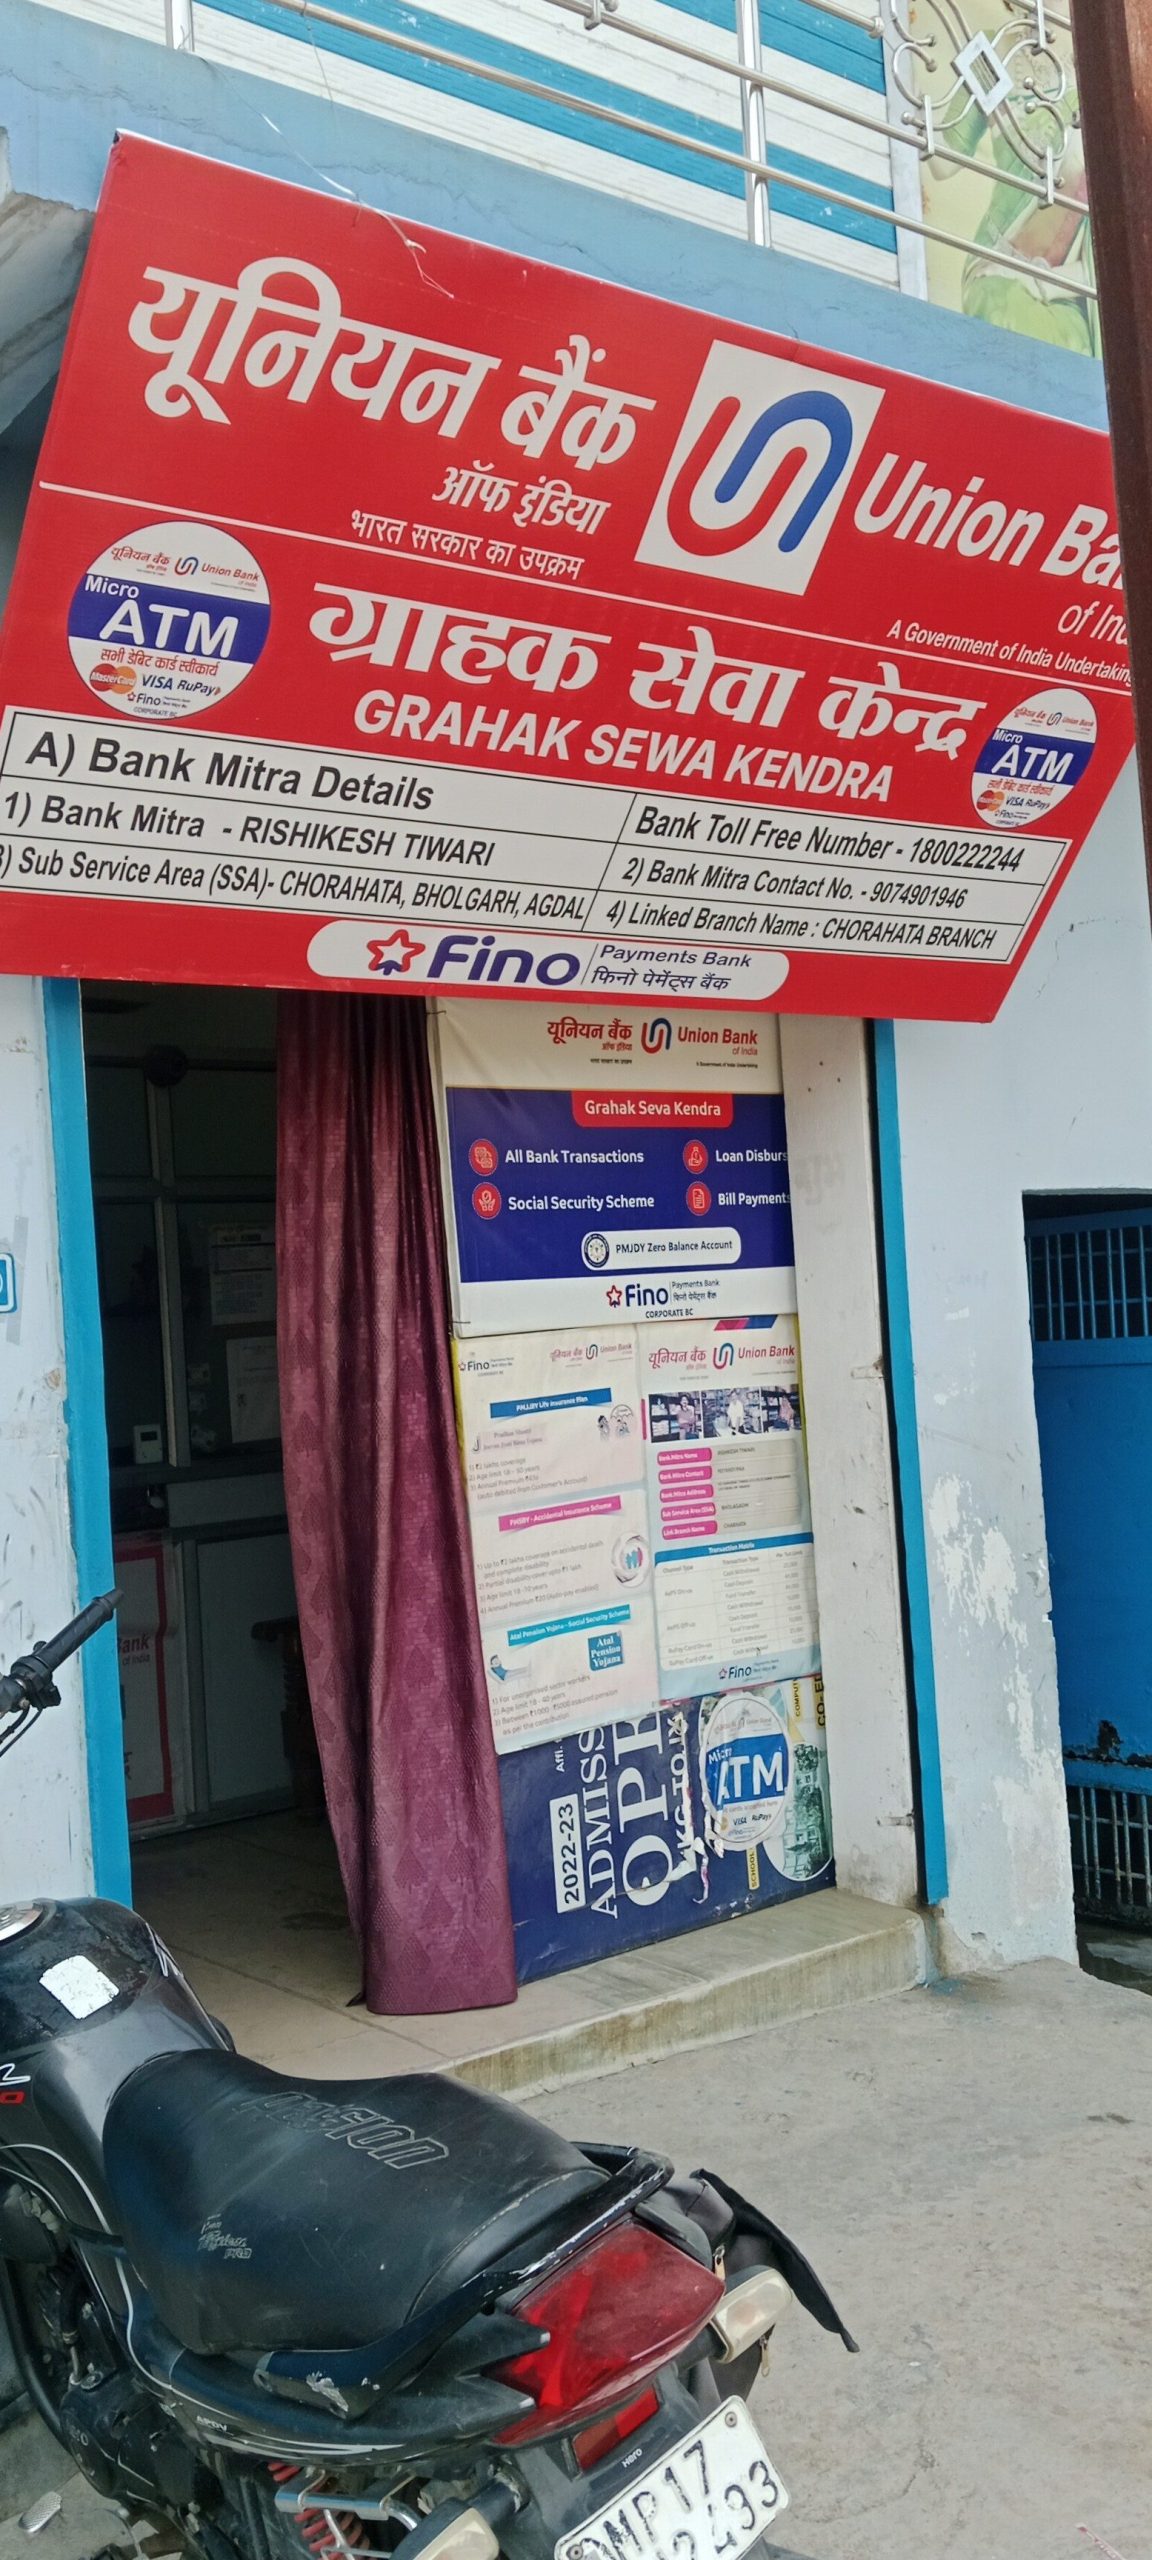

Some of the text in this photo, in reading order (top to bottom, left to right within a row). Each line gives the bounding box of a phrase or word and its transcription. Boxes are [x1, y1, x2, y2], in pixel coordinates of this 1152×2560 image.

[128, 257, 656, 470] यूनियन बैंक
[432, 460, 611, 535] ऑफ इंडिया
[853, 452, 1124, 590] Union Ba
[111, 546, 170, 566] यूनियन बैंक
[350, 510, 586, 580] भारत सरकार का उपक्रम
[201, 563, 259, 582] Union Bank
[85, 575, 139, 599] Micro
[99, 599, 239, 659] ATM
[1058, 601, 1100, 634] of
[887, 619, 902, 640] A
[905, 623, 996, 660] Government
[998, 642, 1019, 660] of
[1017, 644, 1052, 668] India
[101, 648, 128, 664] सभी
[127, 650, 153, 668] डेबिट
[155, 655, 179, 672] कार्ड
[309, 582, 986, 760] ग्राहक सेवा केन्द्र
[142, 673, 174, 690] VISA
[177, 679, 215, 696] RuPay
[136, 693, 161, 706] Fino
[354, 689, 893, 803] GRAHAK SEWA KENDRA
[992, 728, 1023, 744] Micro
[25, 731, 434, 811] A) Bank Mitra Details
[991, 744, 1074, 782] ATM
[1006, 795, 1024, 806] VISA
[5, 791, 496, 867] 1) Bank Mitra RISHIKESH TIWARI
[635, 805, 1024, 873] Bank Toll Free Number 1800222244
[19, 846, 63, 876] Sub
[70, 849, 151, 884] Service
[154, 858, 205, 888] Area
[279, 870, 405, 909] CHORAHATA,
[411, 882, 521, 917] BHOLGARH,
[524, 892, 585, 921] AGDAL
[622, 856, 968, 910] 2) Bank Mitra Contact No. 9074901946
[606, 898, 997, 950] 4) Linked Branch Name CHORAHATA BRANCH
[426, 934, 580, 985] Fino
[600, 943, 752, 969] Payments Bank
[591, 962, 636, 986] फिनो
[699, 968, 731, 992] बैंक
[547, 1016, 633, 1044] यूनियन बैंक
[678, 1026, 758, 1045] Union Bank
[742, 1046, 758, 1055] India
[584, 1100, 721, 1116] Grahak Seva Kendra
[505, 1149, 644, 1164] All Bank Transactions
[715, 1149, 788, 1162] Loan Disburs
[508, 1194, 655, 1212] Social Security Scheme
[718, 1192, 736, 1206] Bill
[615, 1239, 733, 1254] PMJDY Zero Balance Account
[625, 1283, 669, 1307] Fino
[671, 1279, 720, 1290] Payments Bank
[645, 1308, 694, 1319] CORPORATE BC
[648, 1347, 687, 1369] यूनियन
[690, 1346, 706, 1362] बैंक
[738, 1345, 795, 1359] Union Bank
[467, 1361, 490, 1372] Fino
[591, 1645, 621, 1658] Pension
[597, 1636, 614, 1647] Atal
[592, 1655, 621, 1668] Yojana
[728, 1665, 751, 1679] Fino
[793, 1678, 801, 1717] COMPUT
[716, 1750, 784, 1806] ATM
[612, 1710, 673, 1906] OPE
[578, 1725, 618, 1920] ADMISS
[558, 1803, 580, 1904] 2022-23
[621, 2447, 643, 2468] Hero
